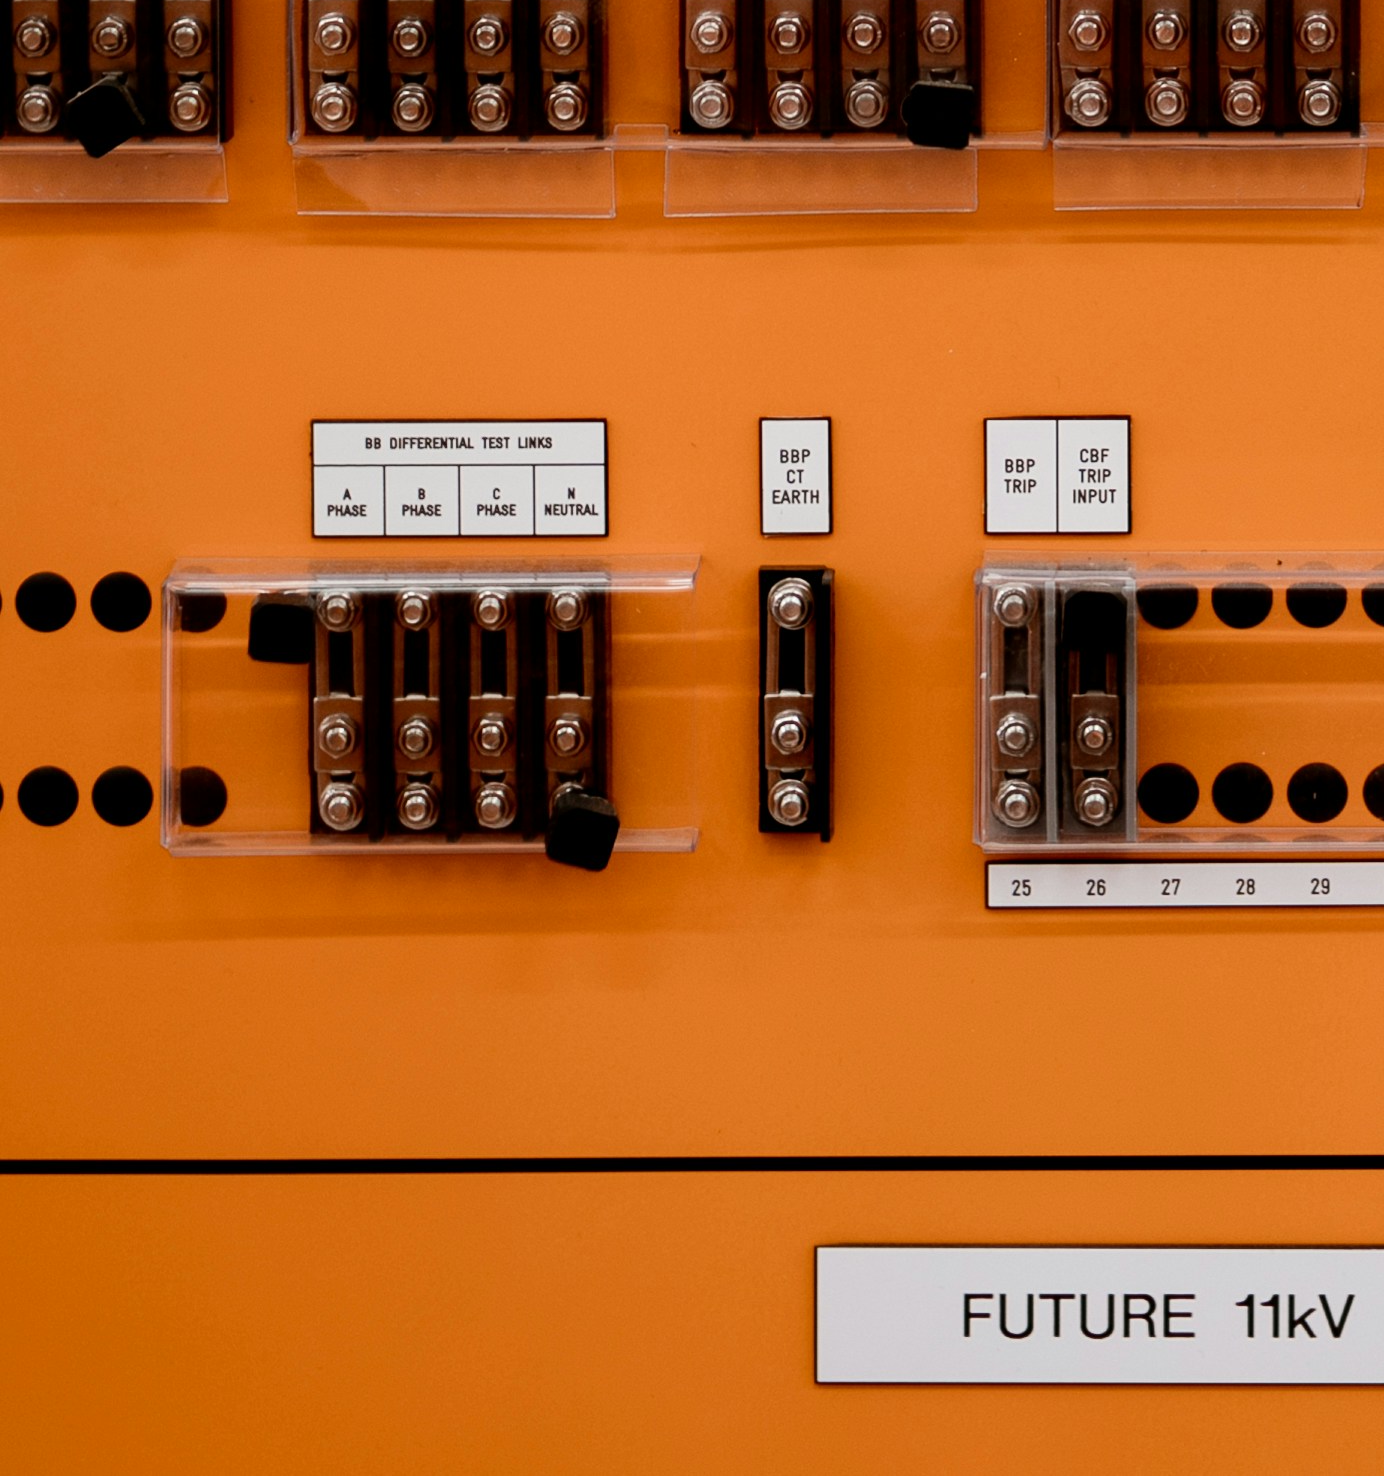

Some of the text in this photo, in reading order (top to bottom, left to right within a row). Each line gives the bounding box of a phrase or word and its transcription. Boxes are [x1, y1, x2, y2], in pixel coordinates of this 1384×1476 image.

[365, 436, 553, 450] BB DIFFERENTIAL TEST LINKS
[779, 448, 811, 464] BBP
[1079, 448, 1110, 464] CBF
[1004, 458, 1036, 474] BBP
[786, 468, 805, 485] CT
[1078, 468, 1112, 484] TRIP
[1003, 478, 1037, 494] TRIP
[772, 489, 820, 505] EARTH
[1072, 488, 1117, 504] INPUT
[1011, 878, 1032, 897] 25
[1086, 878, 1107, 897] 26
[1161, 878, 1181, 896] 27
[1235, 878, 1256, 896] 28
[1310, 877, 1331, 895] 29
[963, 1293, 1196, 1340] FUTURE
[1235, 1293, 1355, 1339] 11kV
